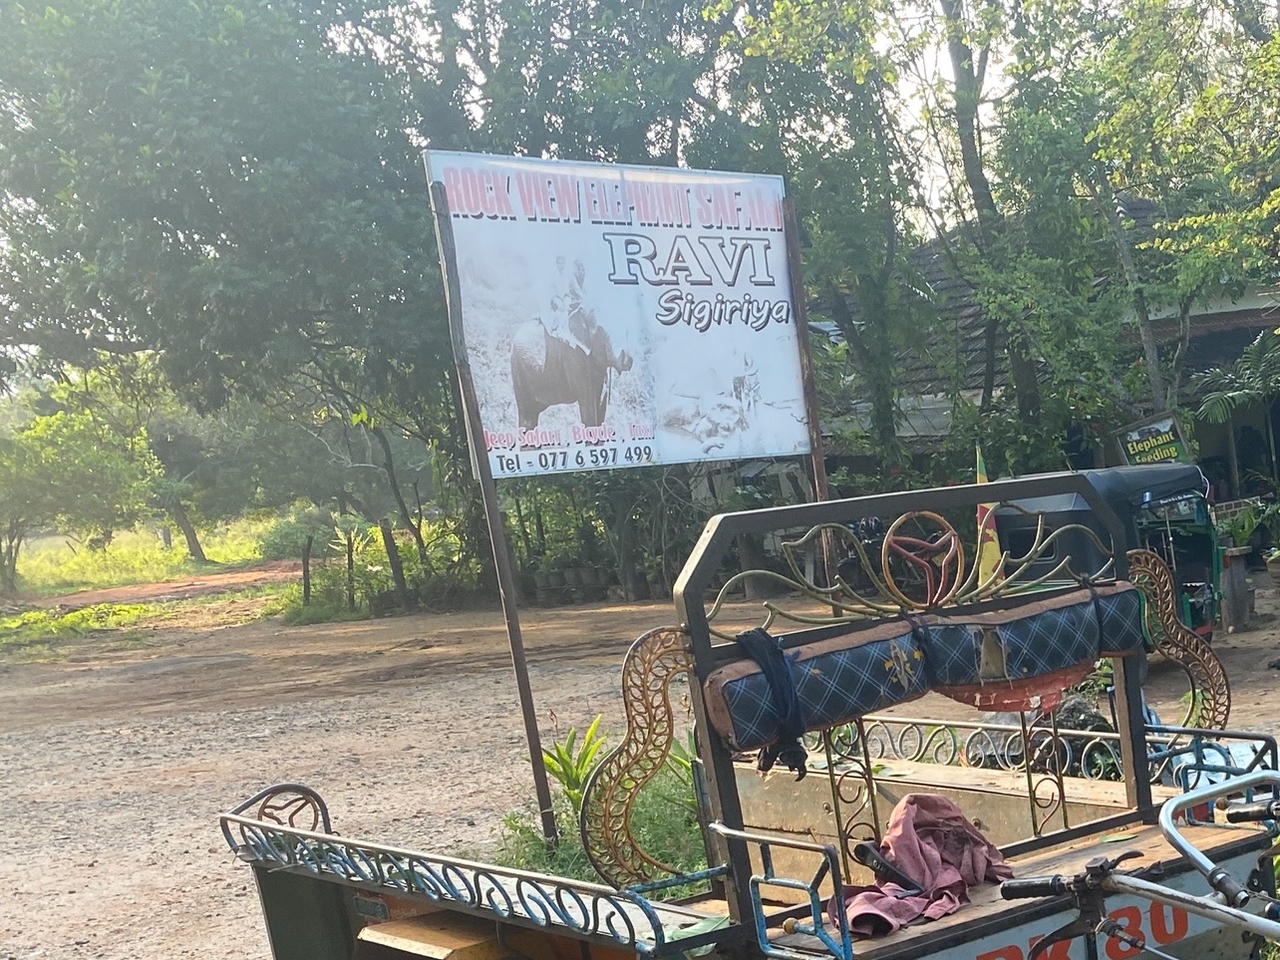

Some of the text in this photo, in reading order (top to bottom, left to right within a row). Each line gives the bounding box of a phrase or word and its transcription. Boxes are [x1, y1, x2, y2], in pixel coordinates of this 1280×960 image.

[443, 167, 783, 232] ROCK VIEW ELEPHANT SAFARI
[603, 232, 775, 287] RAVI
[656, 288, 790, 333] Sigiriya
[484, 429, 516, 452] Jeep
[518, 427, 561, 448] Safari
[572, 424, 616, 446] Bicycle
[496, 454, 522, 473] Tel
[538, 451, 568, 470] 077
[575, 450, 585, 467] 6
[589, 448, 617, 466] 597
[624, 445, 653, 463] 499
[1127, 431, 1175, 455] Elephant
[1105, 899, 1189, 960] 80
